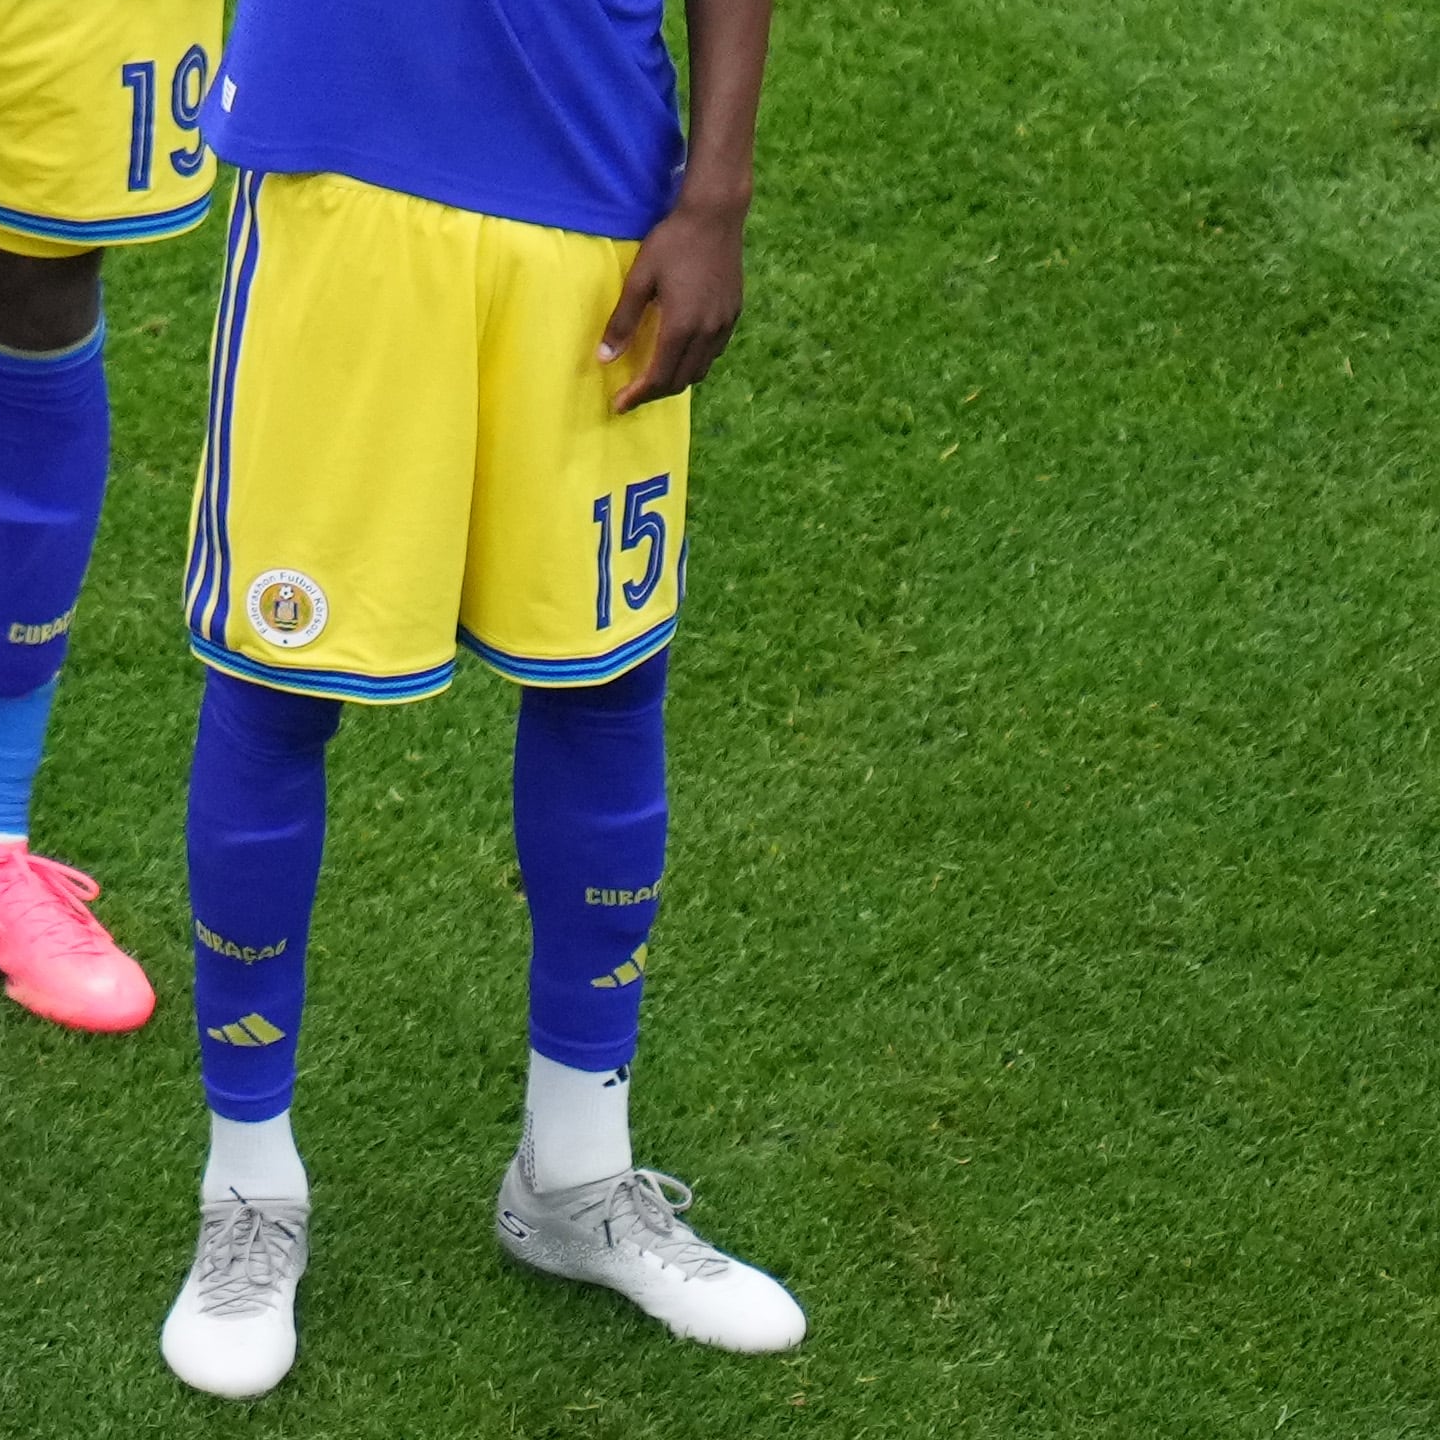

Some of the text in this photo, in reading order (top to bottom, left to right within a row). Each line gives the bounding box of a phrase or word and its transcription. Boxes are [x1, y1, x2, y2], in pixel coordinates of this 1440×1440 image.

[122, 43, 208, 192] 19
[593, 472, 671, 631] 15
[195, 918, 288, 966] CURAÇAO
